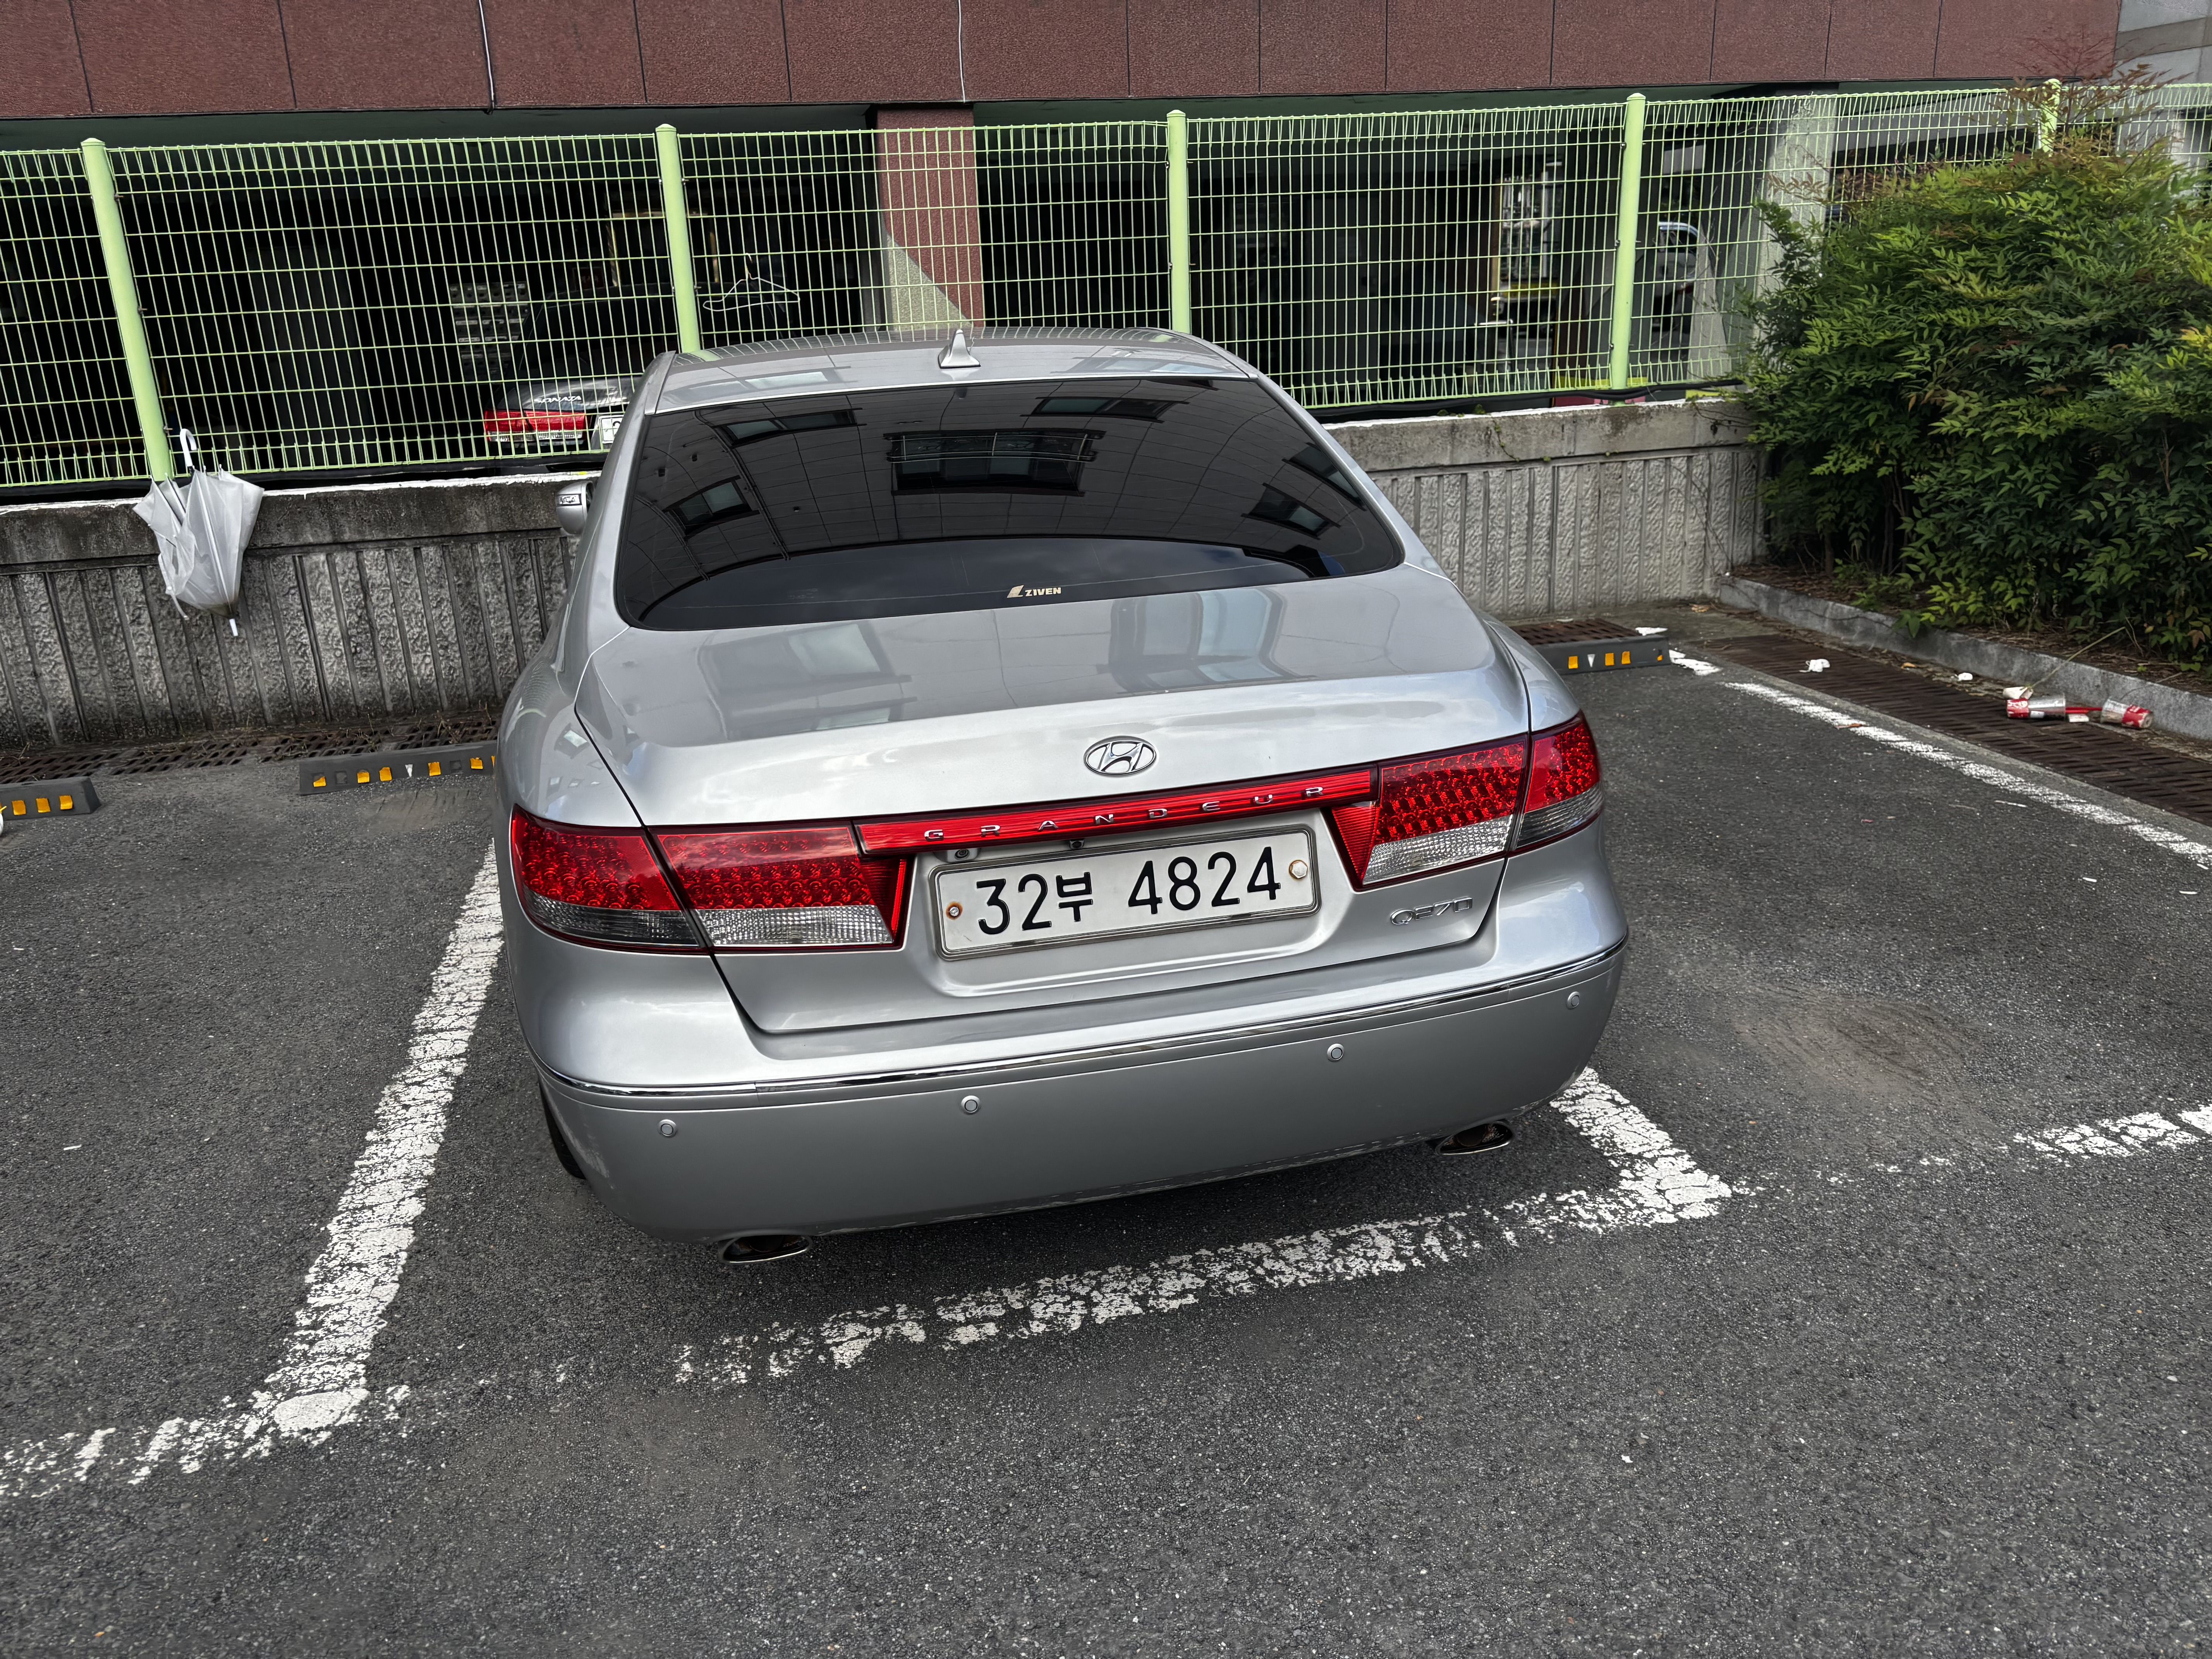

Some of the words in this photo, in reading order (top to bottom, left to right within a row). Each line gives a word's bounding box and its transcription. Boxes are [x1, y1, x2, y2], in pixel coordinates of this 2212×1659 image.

[534, 395, 582, 404] SONATA
[1025, 587, 1061, 597] ZIVEN
[924, 787, 1323, 841] GRANDEUR
[975, 871, 1093, 935] 32부
[1128, 846, 1281, 915] 4824
[1389, 895, 1473, 926] Q270
